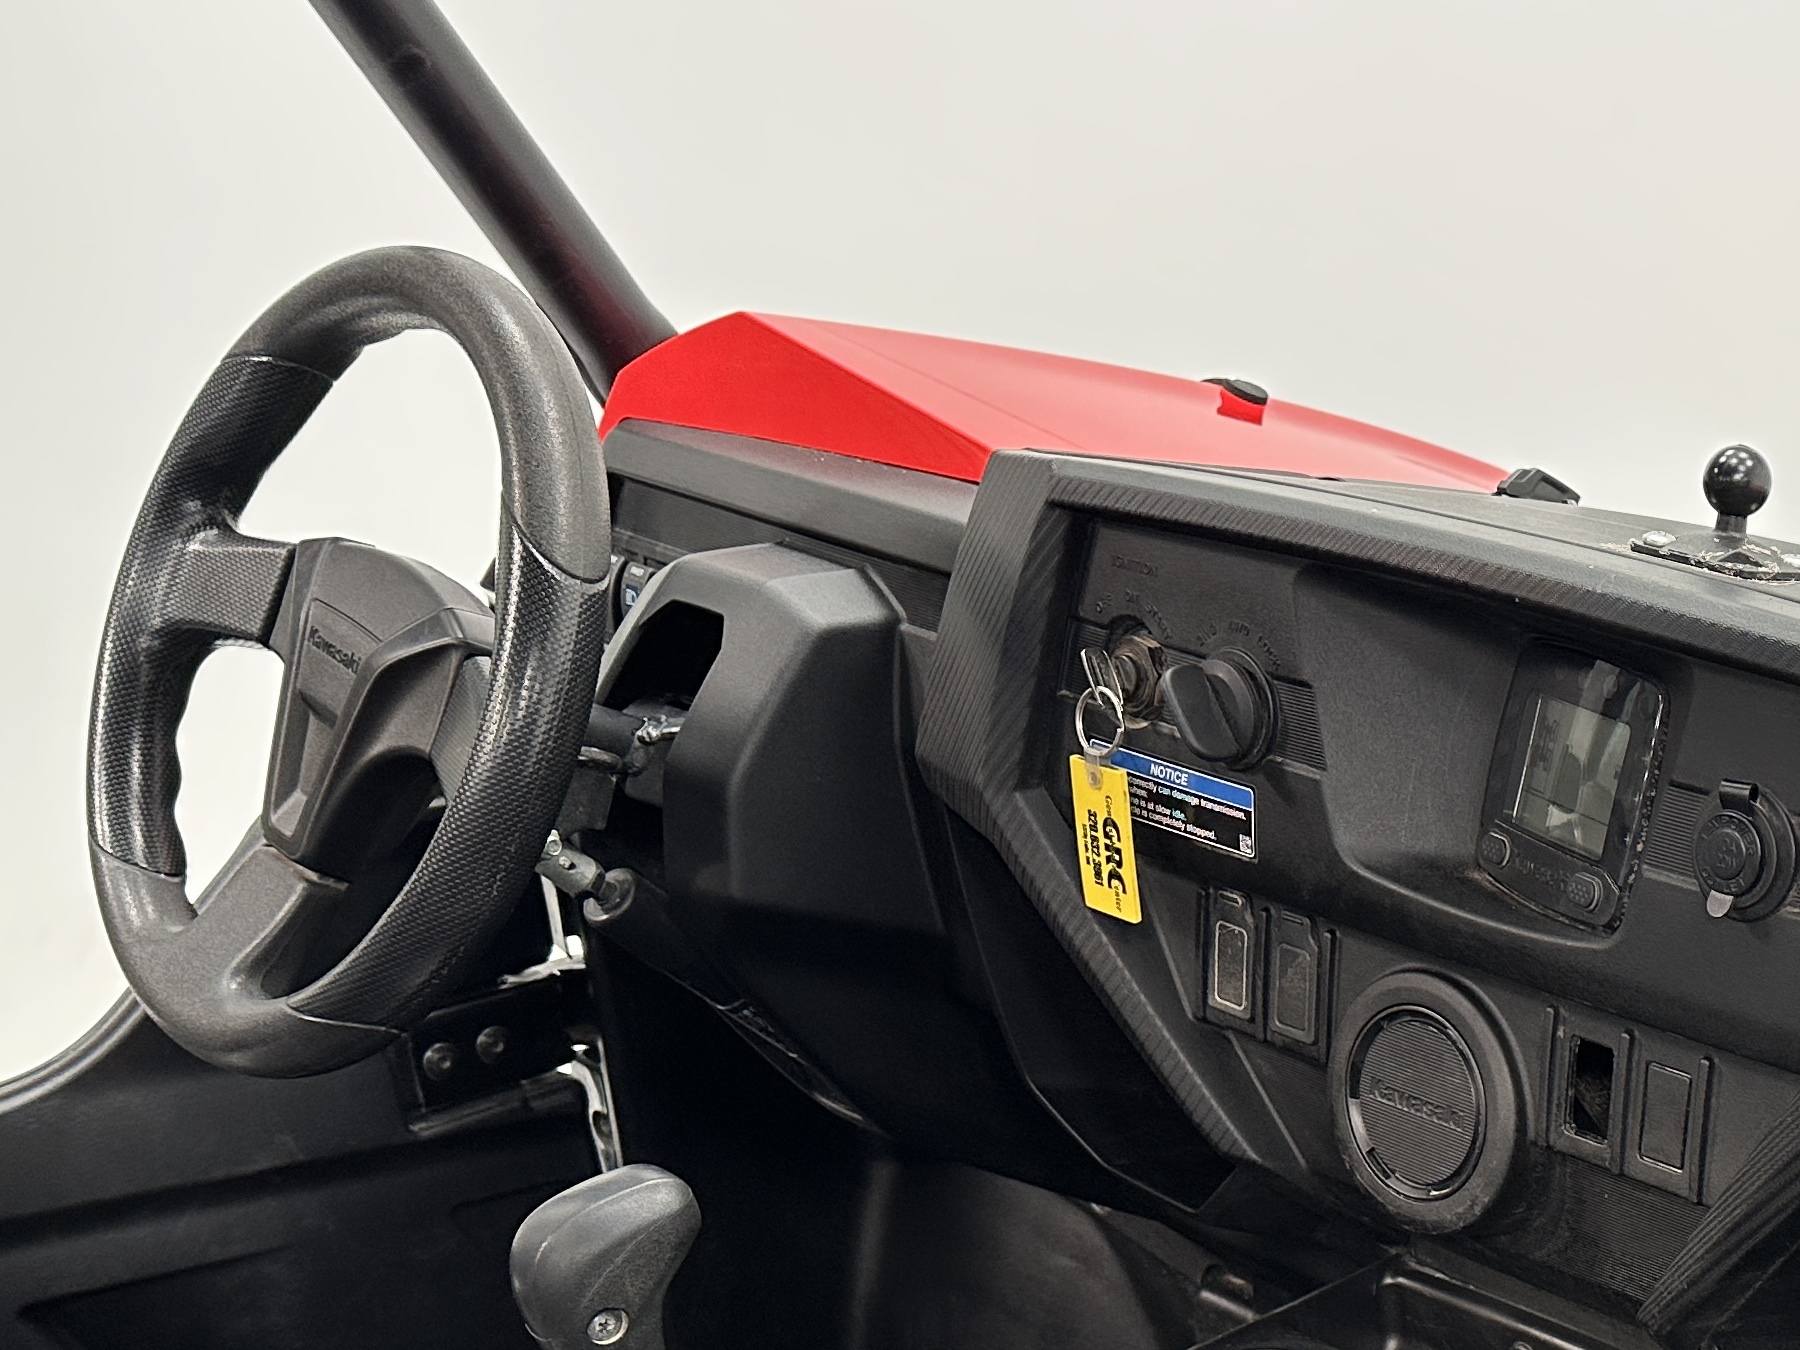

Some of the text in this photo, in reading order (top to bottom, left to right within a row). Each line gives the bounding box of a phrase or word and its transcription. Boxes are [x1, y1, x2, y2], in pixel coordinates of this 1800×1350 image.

[308, 625, 362, 675] Kawasaki
[1150, 763, 1189, 786] NOTICE
[1172, 789, 1200, 806] damage
[1186, 823, 1218, 841] stopped.
[1102, 816, 1128, 896] GRC
[1369, 1076, 1467, 1131] Kawasaki
